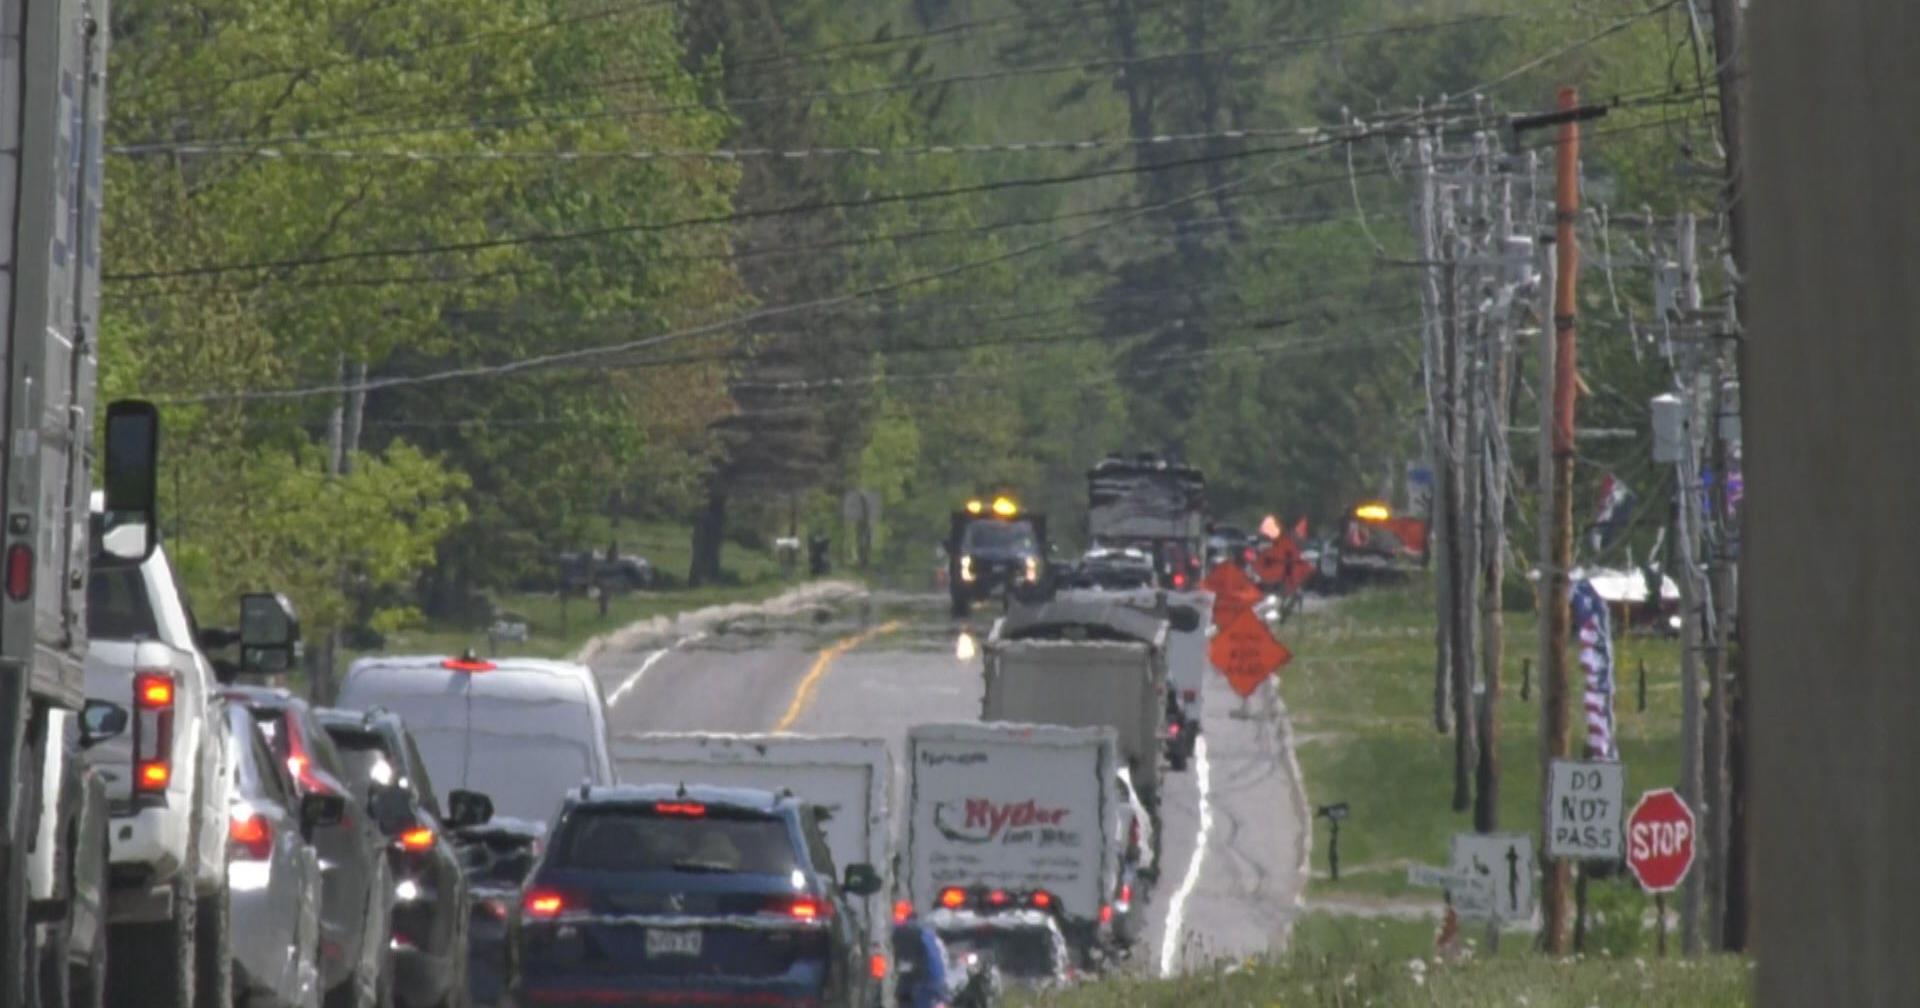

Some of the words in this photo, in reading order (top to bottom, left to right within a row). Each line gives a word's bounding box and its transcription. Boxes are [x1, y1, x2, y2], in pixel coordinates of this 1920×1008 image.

[1571, 769, 1602, 791] DO
[1562, 796, 1610, 821] NOT
[1556, 826, 1611, 849] PASS
[1632, 820, 1688, 860] STOP
